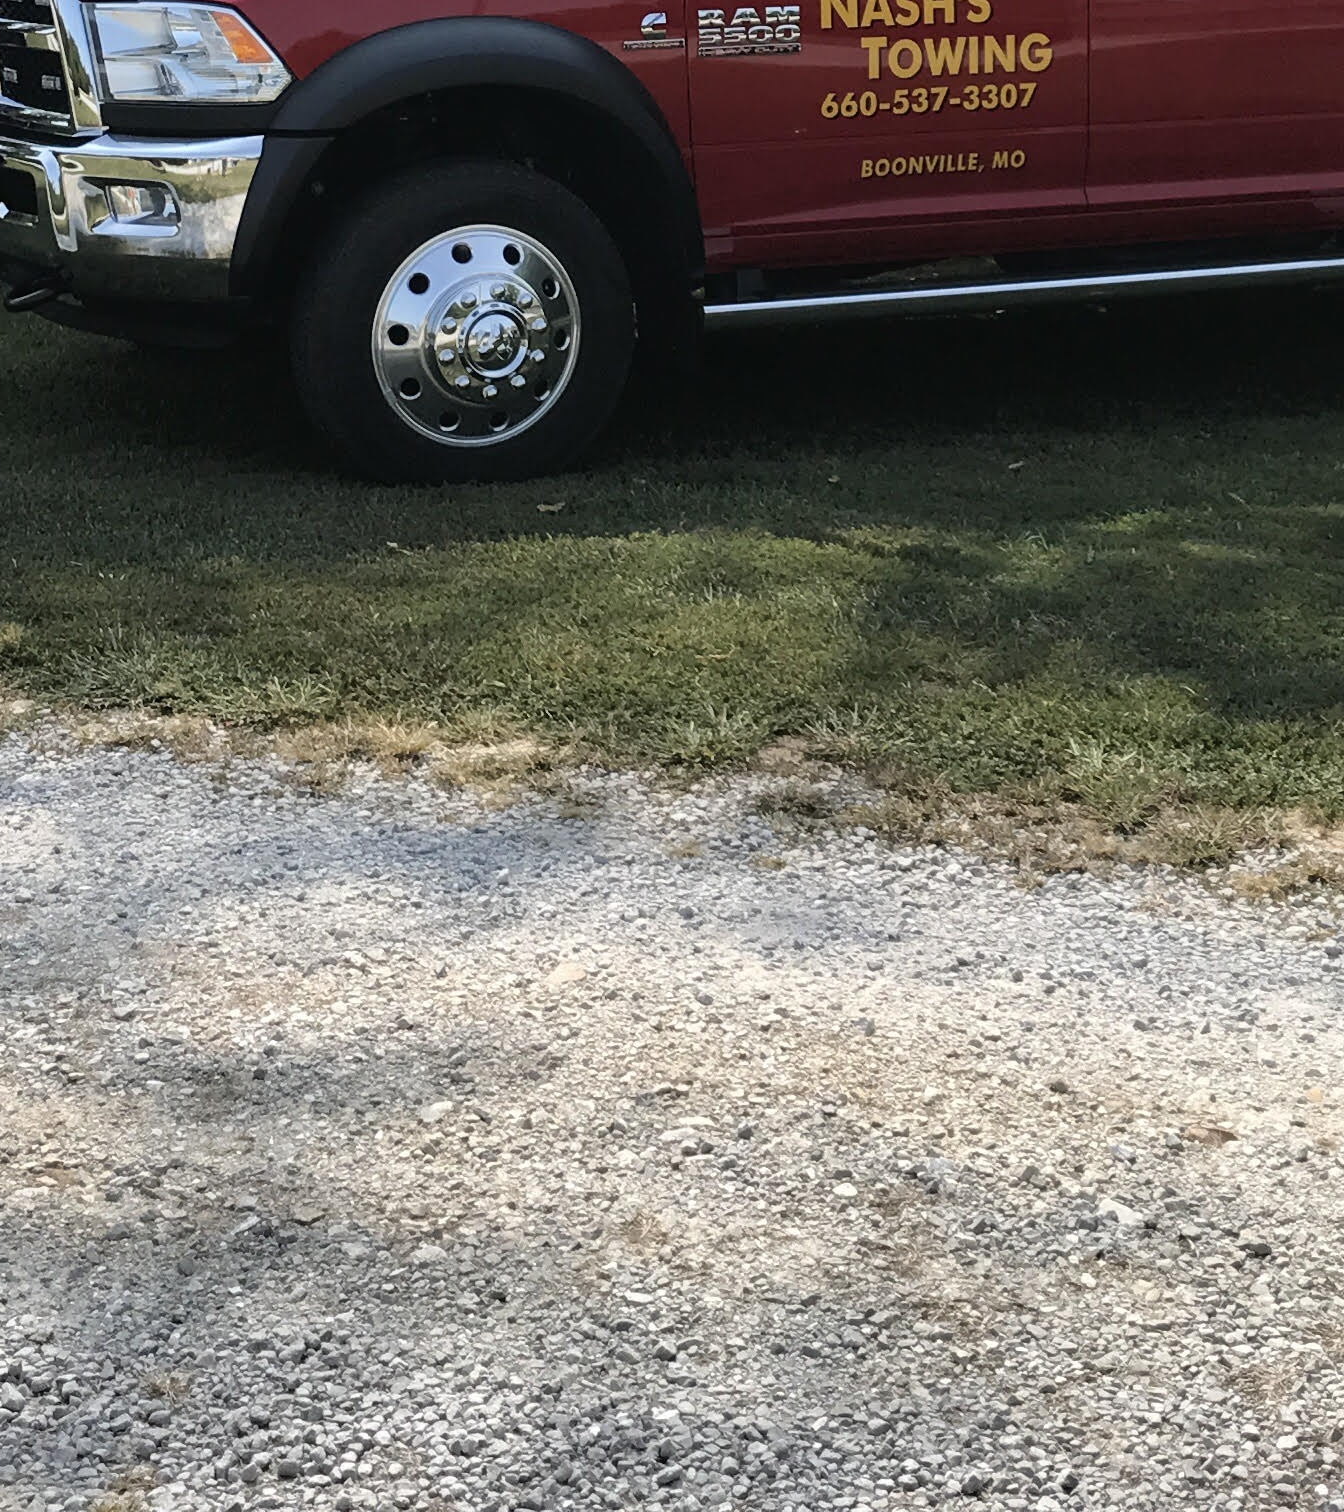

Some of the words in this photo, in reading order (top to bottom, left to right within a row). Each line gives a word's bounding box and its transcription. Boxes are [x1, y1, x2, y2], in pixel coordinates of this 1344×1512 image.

[698, 6, 801, 27] RAM
[698, 25, 801, 45] 5500
[860, 32, 1054, 80] TOWING
[820, 82, 1038, 119] 660-537-3307
[860, 153, 985, 178] BOONVILLE,
[991, 149, 1026, 170] MO
